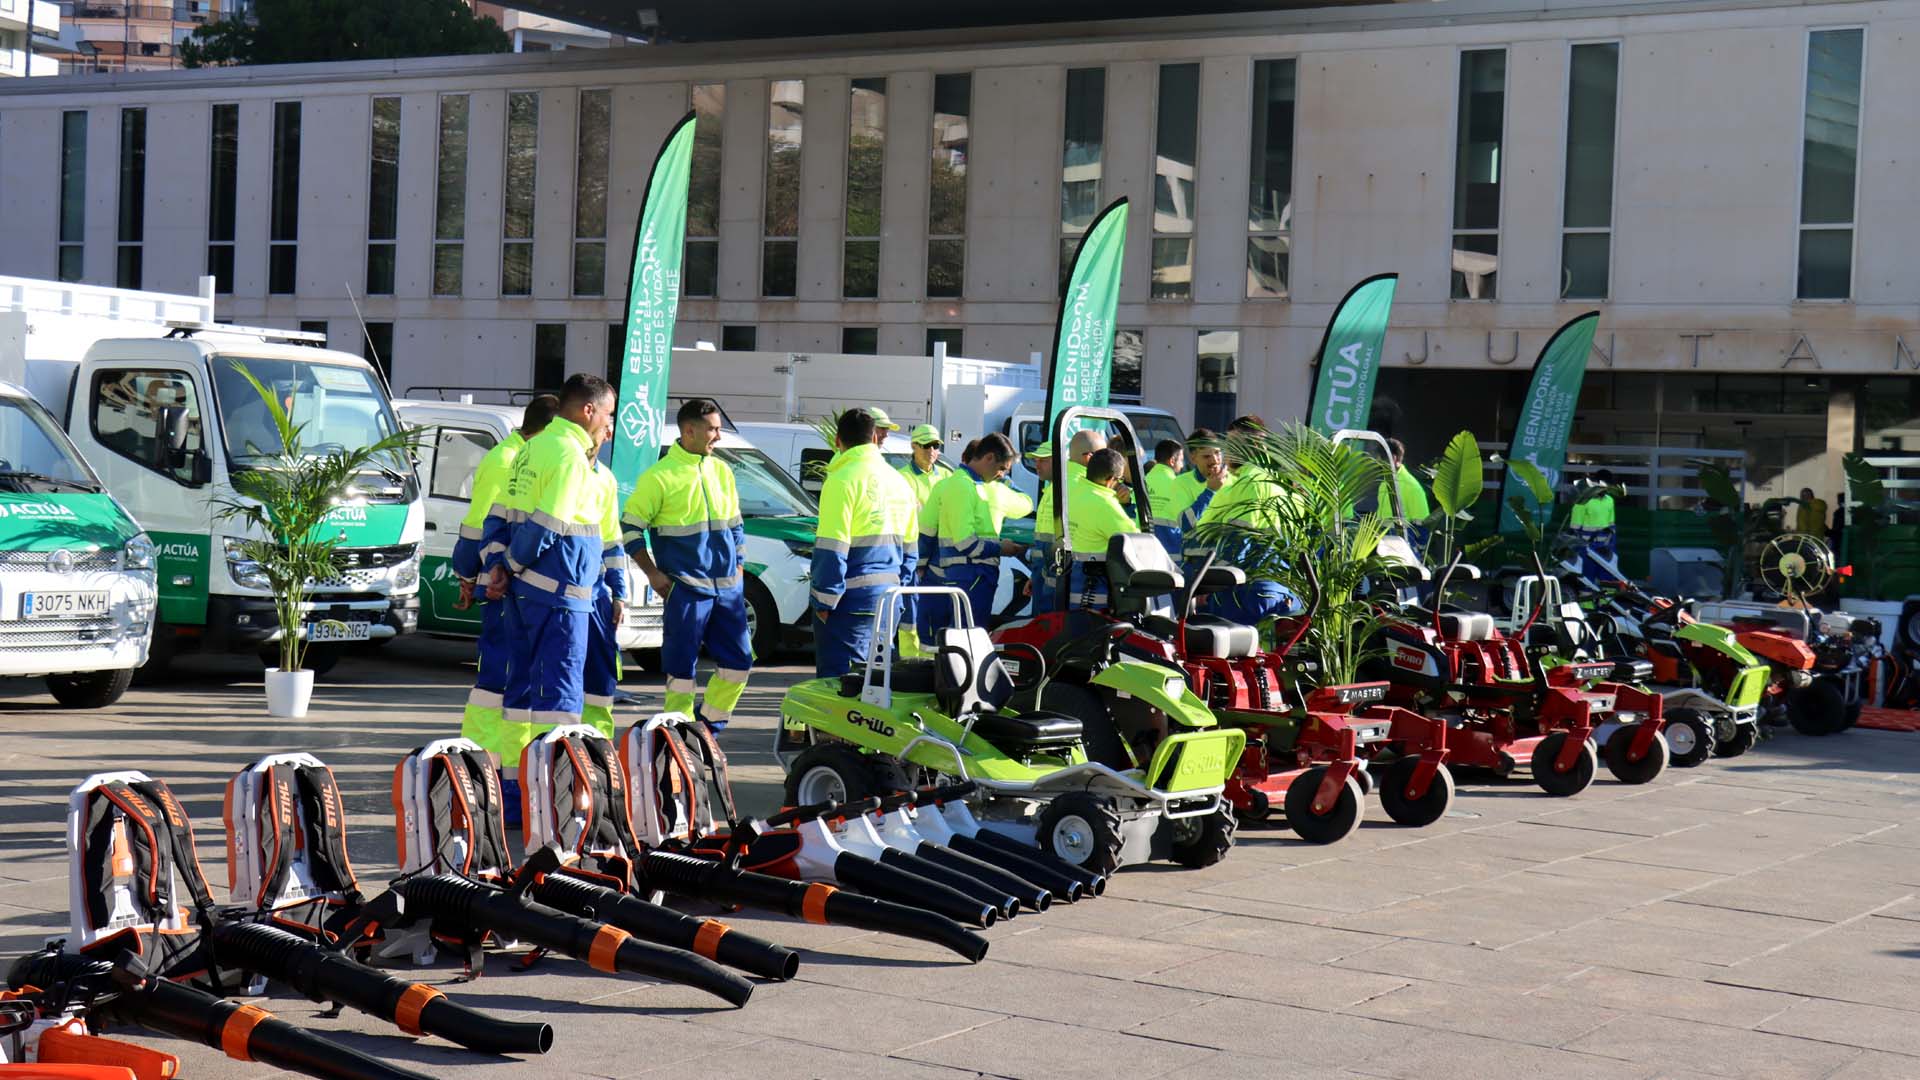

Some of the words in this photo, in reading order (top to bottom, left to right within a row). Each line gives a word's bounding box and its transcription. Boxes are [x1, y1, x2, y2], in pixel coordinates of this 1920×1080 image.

[666, 269, 680, 301] LIFE
[1081, 344, 1091, 358] ES
[1081, 360, 1091, 402] VERDE
[1325, 342, 1363, 430] CTÚA
[1523, 364, 1554, 447] BENIDORM
[10, 501, 76, 516] ACTÚA
[163, 541, 199, 557] ACTÚA
[35, 594, 73, 612] 3075
[78, 593, 106, 611] NKH
[1400, 653, 1424, 665] TORO
[1342, 689, 1351, 703] Z
[1351, 687, 1383, 699] MASTER
[847, 709, 896, 737] Grillo
[577, 747, 598, 782] STIHL
[605, 751, 621, 790] STIHL
[119, 788, 156, 817] STIHL
[457, 766, 476, 805] STIHL
[484, 764, 498, 806] STIHL
[158, 789, 184, 827] STIHL
[278, 780, 292, 826] STIHL
[323, 784, 337, 828] STIHL
